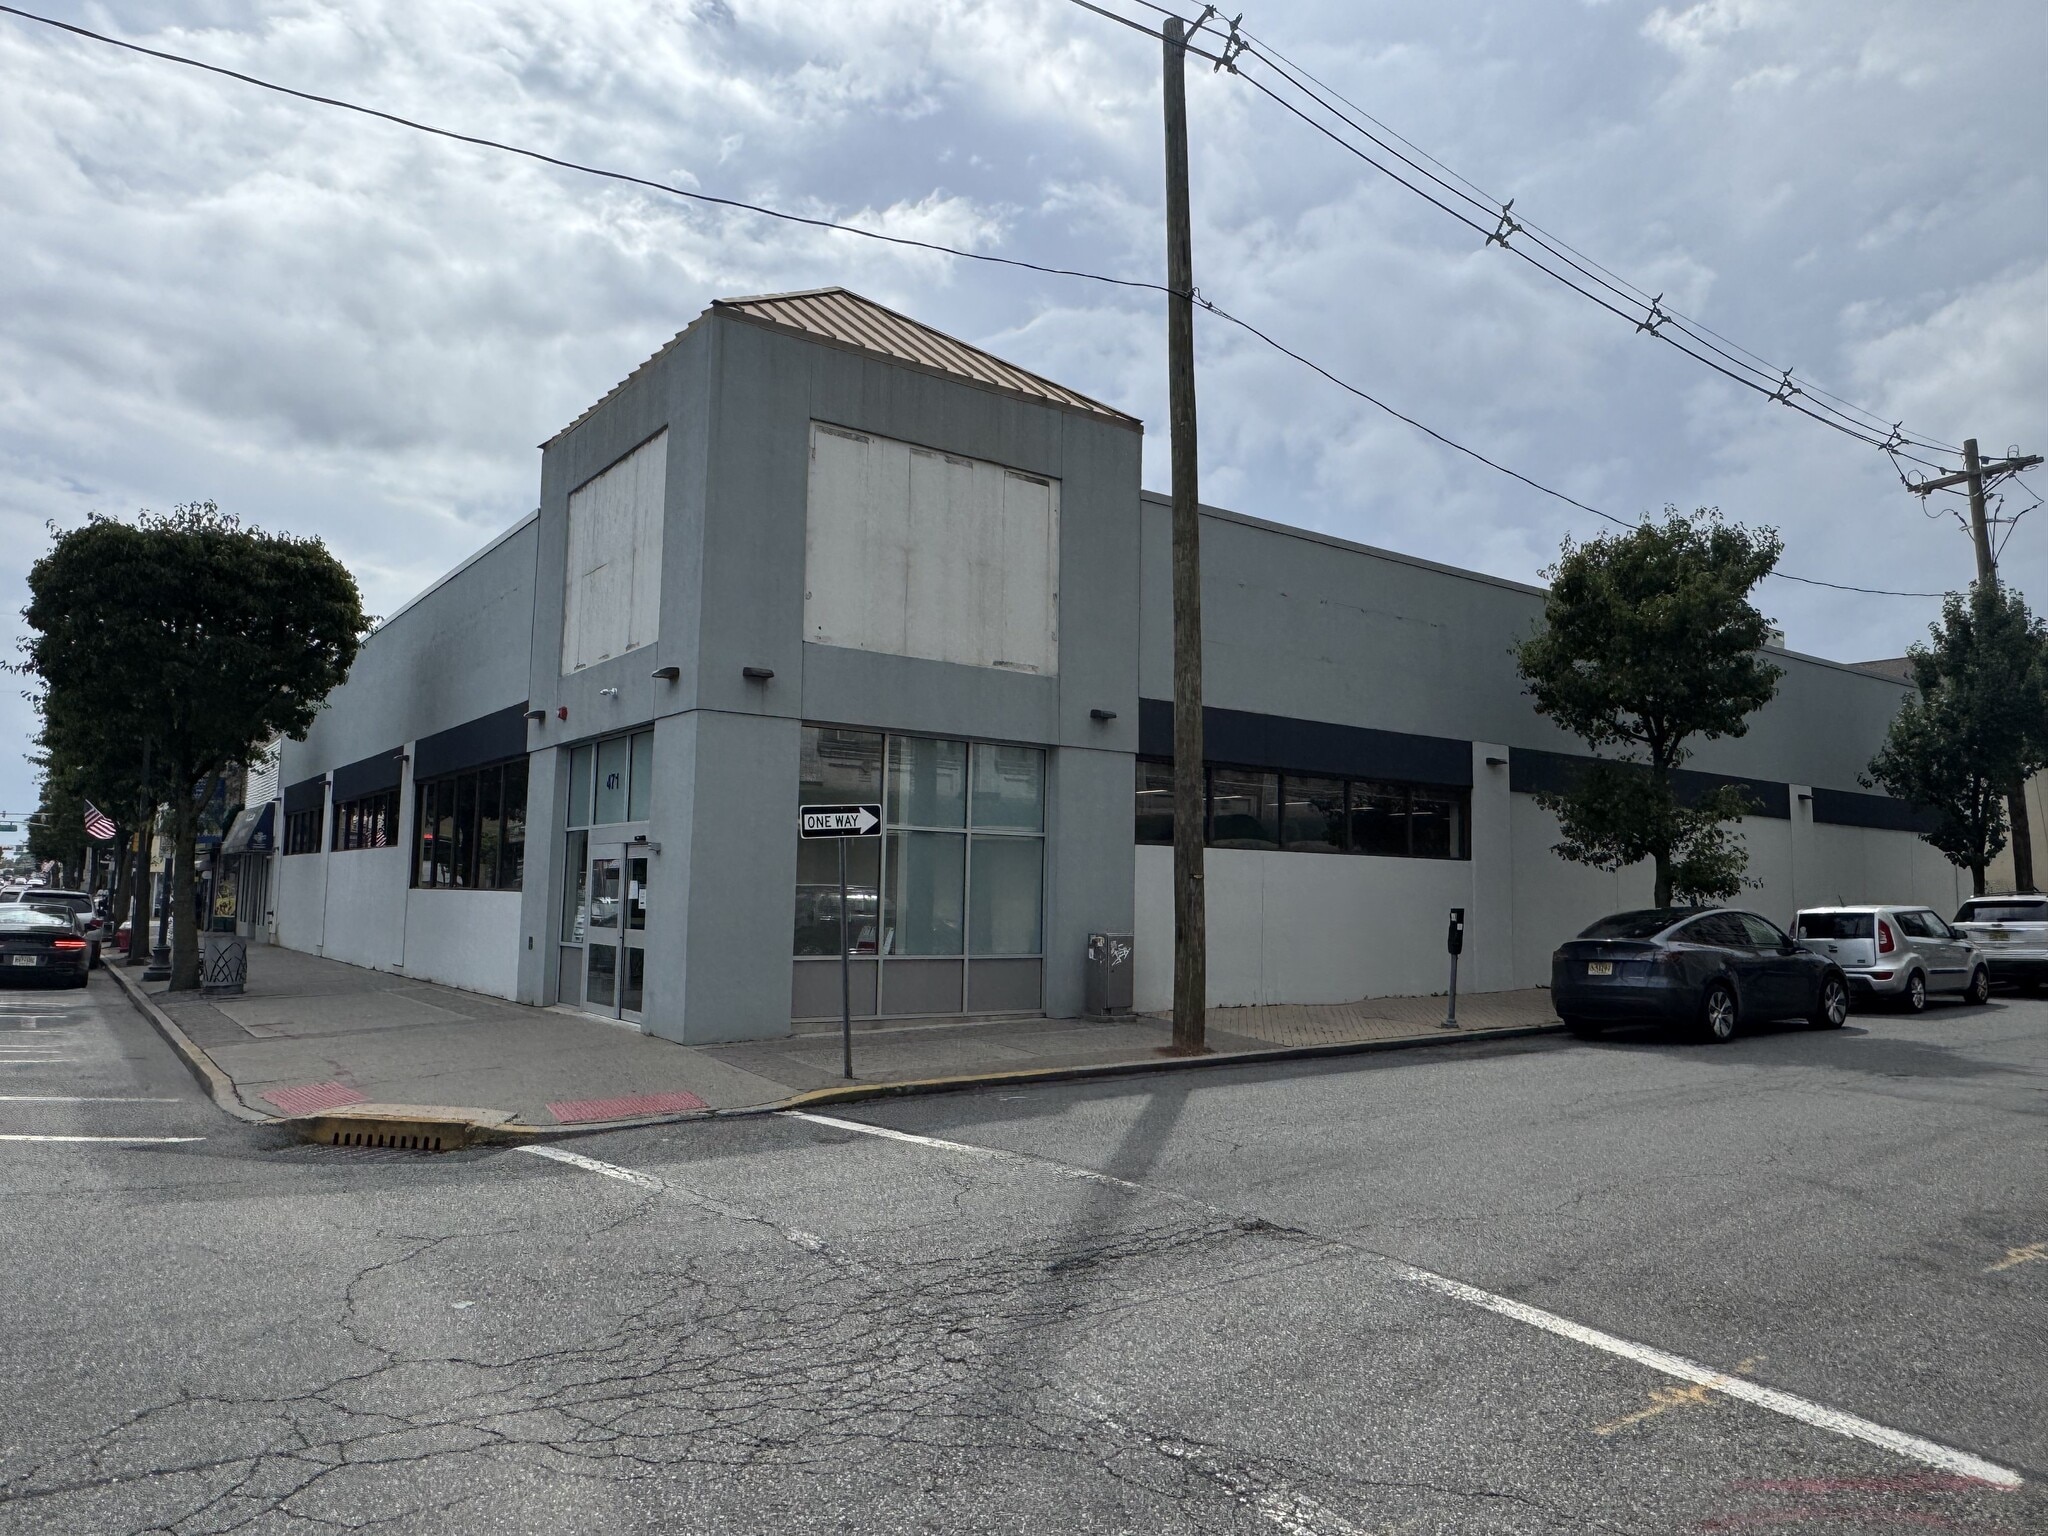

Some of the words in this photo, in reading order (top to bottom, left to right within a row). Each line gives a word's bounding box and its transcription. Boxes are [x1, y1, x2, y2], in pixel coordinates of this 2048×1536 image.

[606, 773, 619, 790] 471
[807, 816, 832, 828] ONE
[835, 815, 859, 827] WAY
